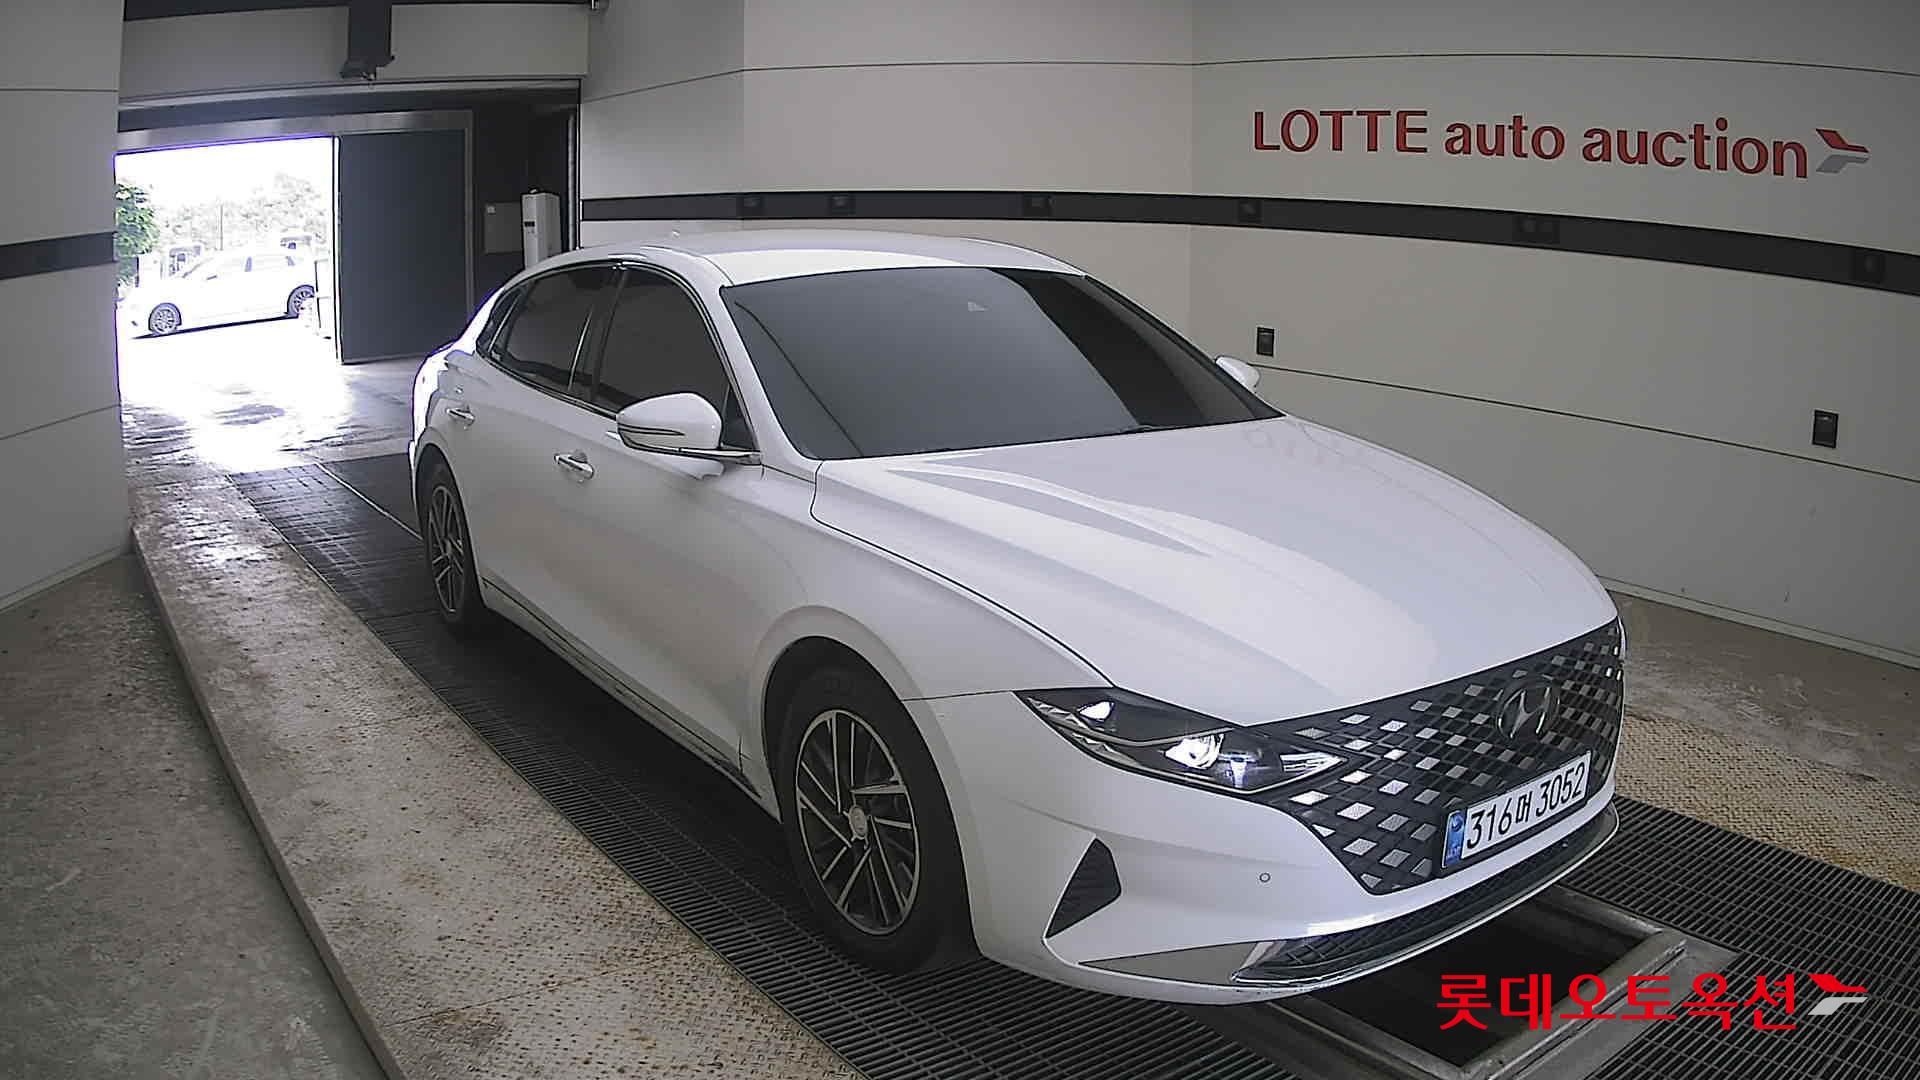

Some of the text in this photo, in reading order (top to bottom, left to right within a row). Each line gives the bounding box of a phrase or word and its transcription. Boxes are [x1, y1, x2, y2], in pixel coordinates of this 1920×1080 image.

[1253, 109, 1808, 179] LOTTE auto auction
[1466, 761, 1586, 850] 316머 3052
